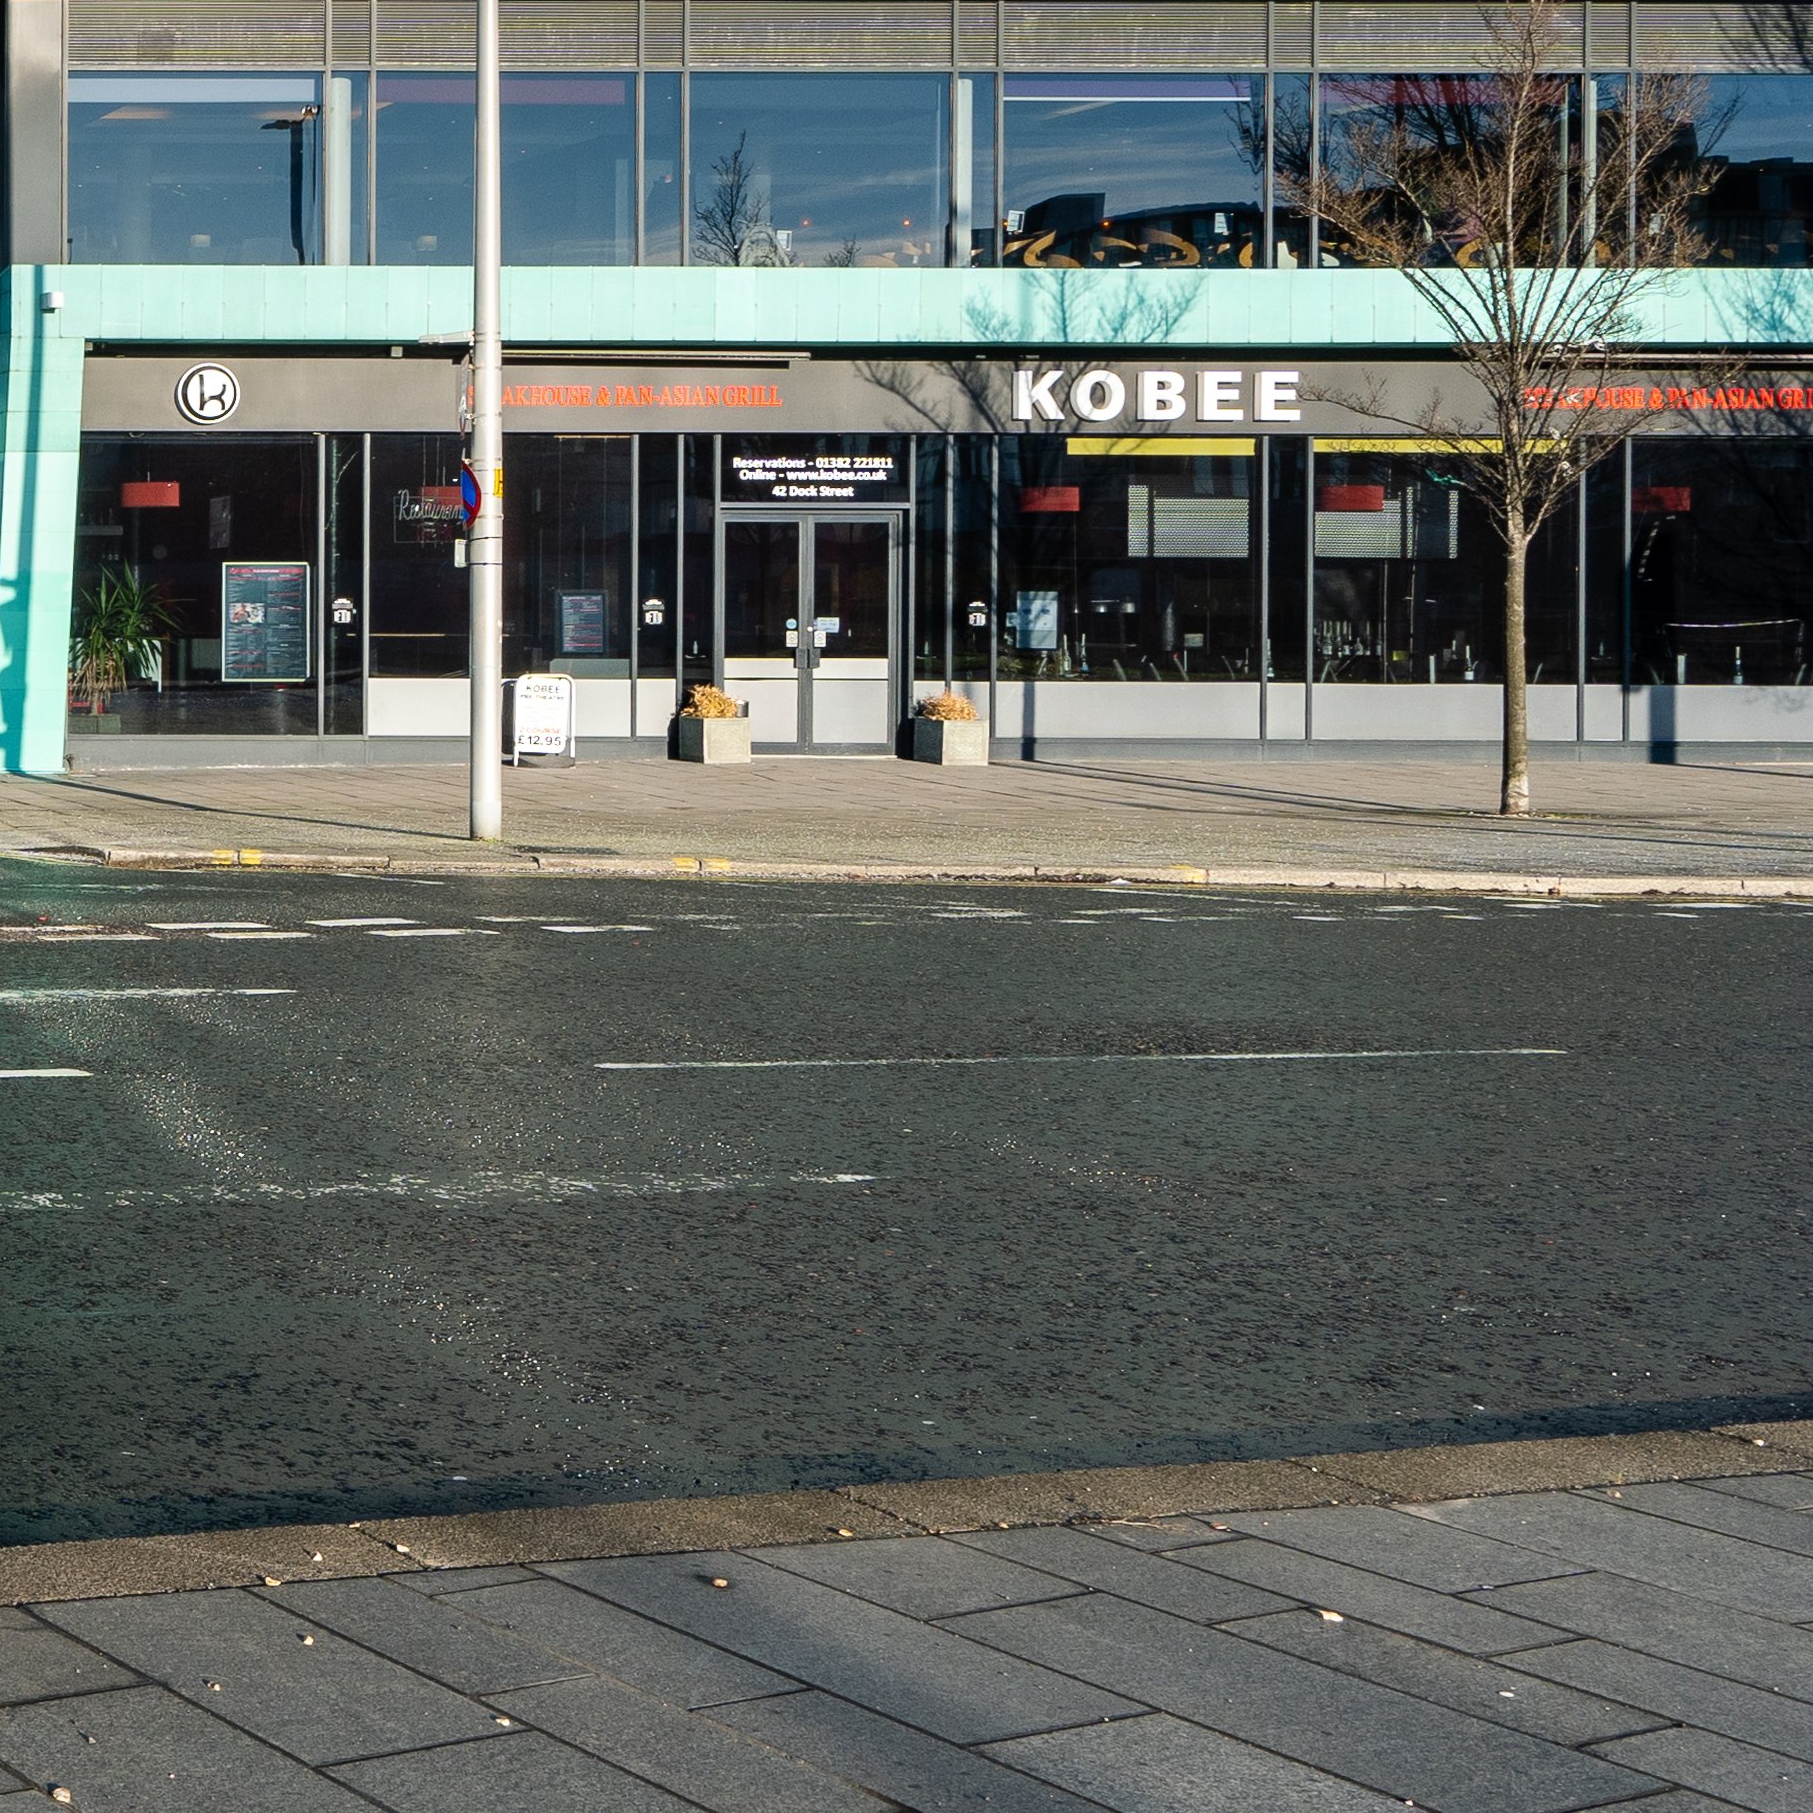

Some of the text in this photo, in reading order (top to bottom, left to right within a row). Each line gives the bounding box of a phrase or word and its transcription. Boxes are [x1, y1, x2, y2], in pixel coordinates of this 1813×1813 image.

[468, 385, 783, 407] AKHOUSE & PAN-ASIAN GRILL
[1012, 369, 1301, 422] KOBEE
[1648, 388, 1664, 409] &
[1667, 388, 1773, 409] PAN-ASIAN
[732, 457, 806, 469] Reservations
[815, 457, 851, 469] 01382
[739, 469, 776, 480] Online
[786, 469, 887, 481] www.kobee.co.uk
[772, 485, 854, 497] 42 Dock Street
[398, 489, 464, 521] Restauran
[518, 735, 562, 746] £12.95
